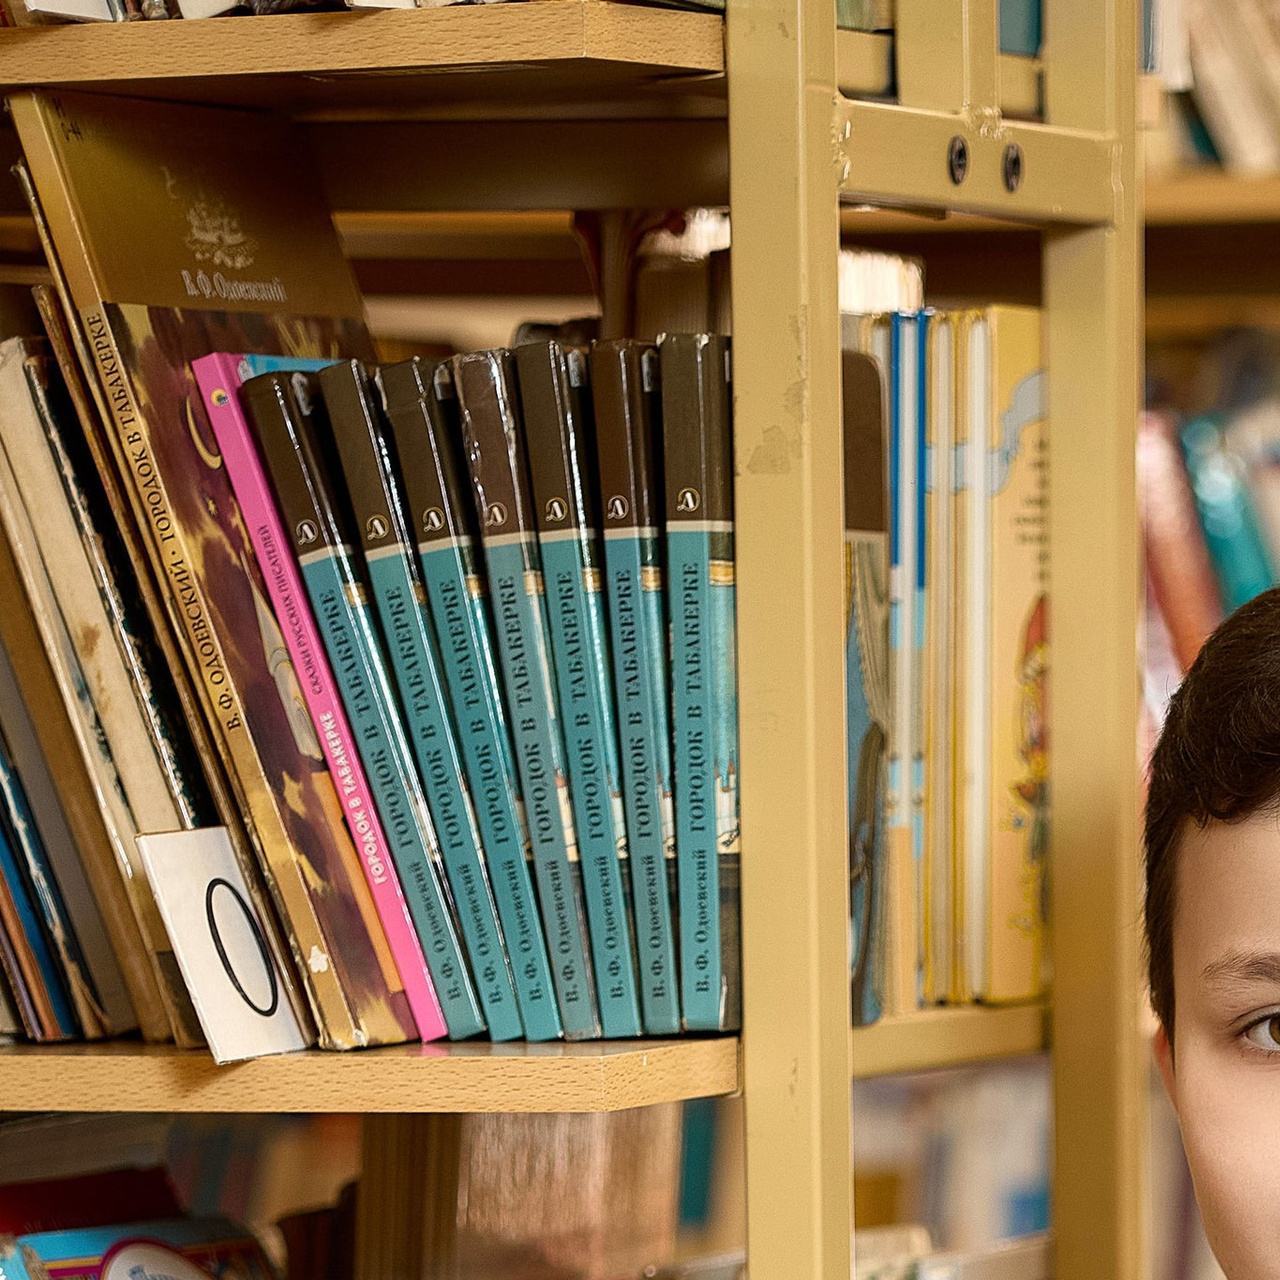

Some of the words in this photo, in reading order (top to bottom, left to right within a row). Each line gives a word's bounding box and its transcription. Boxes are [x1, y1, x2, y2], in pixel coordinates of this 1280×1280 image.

[84, 311, 138, 429] ТАБАКЕРКЕ
[125, 429, 142, 444] В
[129, 444, 177, 544] ГОРОДОК
[256, 524, 288, 594] ПИСАТЕЛЕЙ
[168, 558, 227, 687] ОДОЕВСКИЙ
[280, 594, 307, 648] РУССКИХ
[298, 648, 324, 696] СКАЗКИ
[317, 588, 372, 718] ТАБАКЕРКЕ
[384, 584, 431, 716] ТАБАКЕРКЕ
[440, 578, 482, 709] ТАБАКЕРКЕ
[497, 576, 532, 708] ТАБАКЕРКЕ
[556, 571, 586, 701] ТАБАКЕРКЕ
[613, 570, 640, 701] ТАБАКЕРКЕ
[682, 562, 701, 693] ТАБАКЕРКЕ
[317, 710, 358, 795] ТАБАКЕРКЕ
[361, 723, 380, 742] В
[419, 723, 437, 739] В
[469, 717, 487, 735] В
[519, 717, 536, 731] В
[573, 712, 590, 728] В
[625, 711, 642, 726] В
[686, 704, 702, 717] В
[347, 795, 363, 809] В
[370, 747, 415, 850] ГОРОДОК
[425, 748, 465, 850] ГОРОДОК
[476, 743, 511, 845] ГОРОДОК
[524, 740, 554, 845] ГОРОДОК
[576, 737, 604, 841] ГОРОДОК
[627, 736, 652, 839] ГОРОДОК
[687, 730, 706, 832] ГОРОДОК
[350, 808, 389, 885] ГОРОДОК
